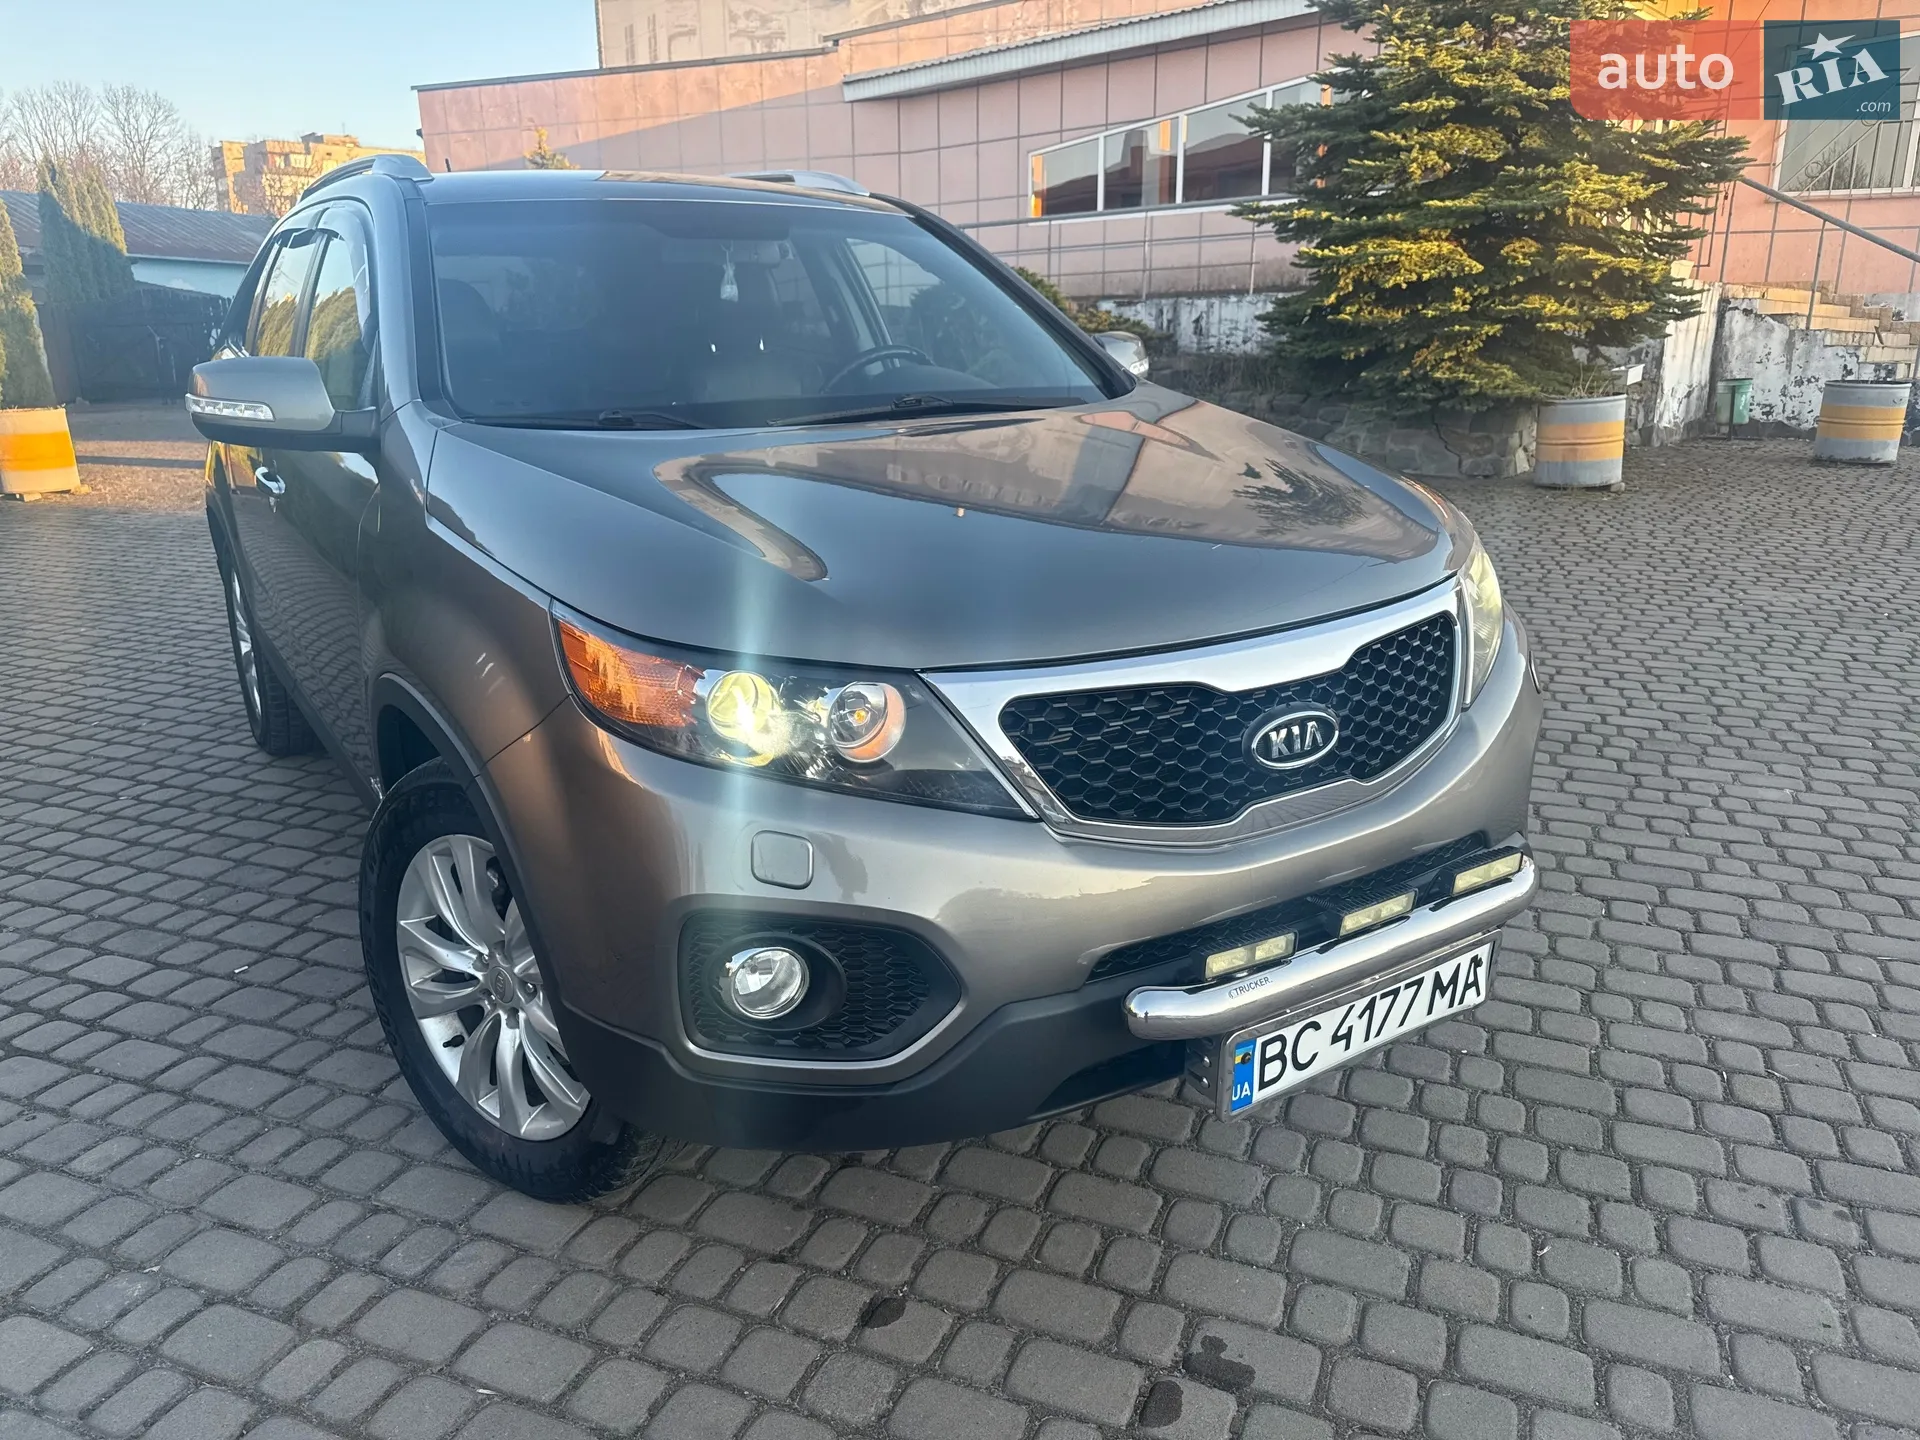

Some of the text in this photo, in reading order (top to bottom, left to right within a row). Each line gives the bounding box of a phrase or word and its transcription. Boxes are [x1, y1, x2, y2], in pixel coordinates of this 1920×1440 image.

[1269, 720, 1324, 759] KIA
[1258, 954, 1483, 1092] BC 4177 MA
[1232, 1081, 1251, 1101] UA
